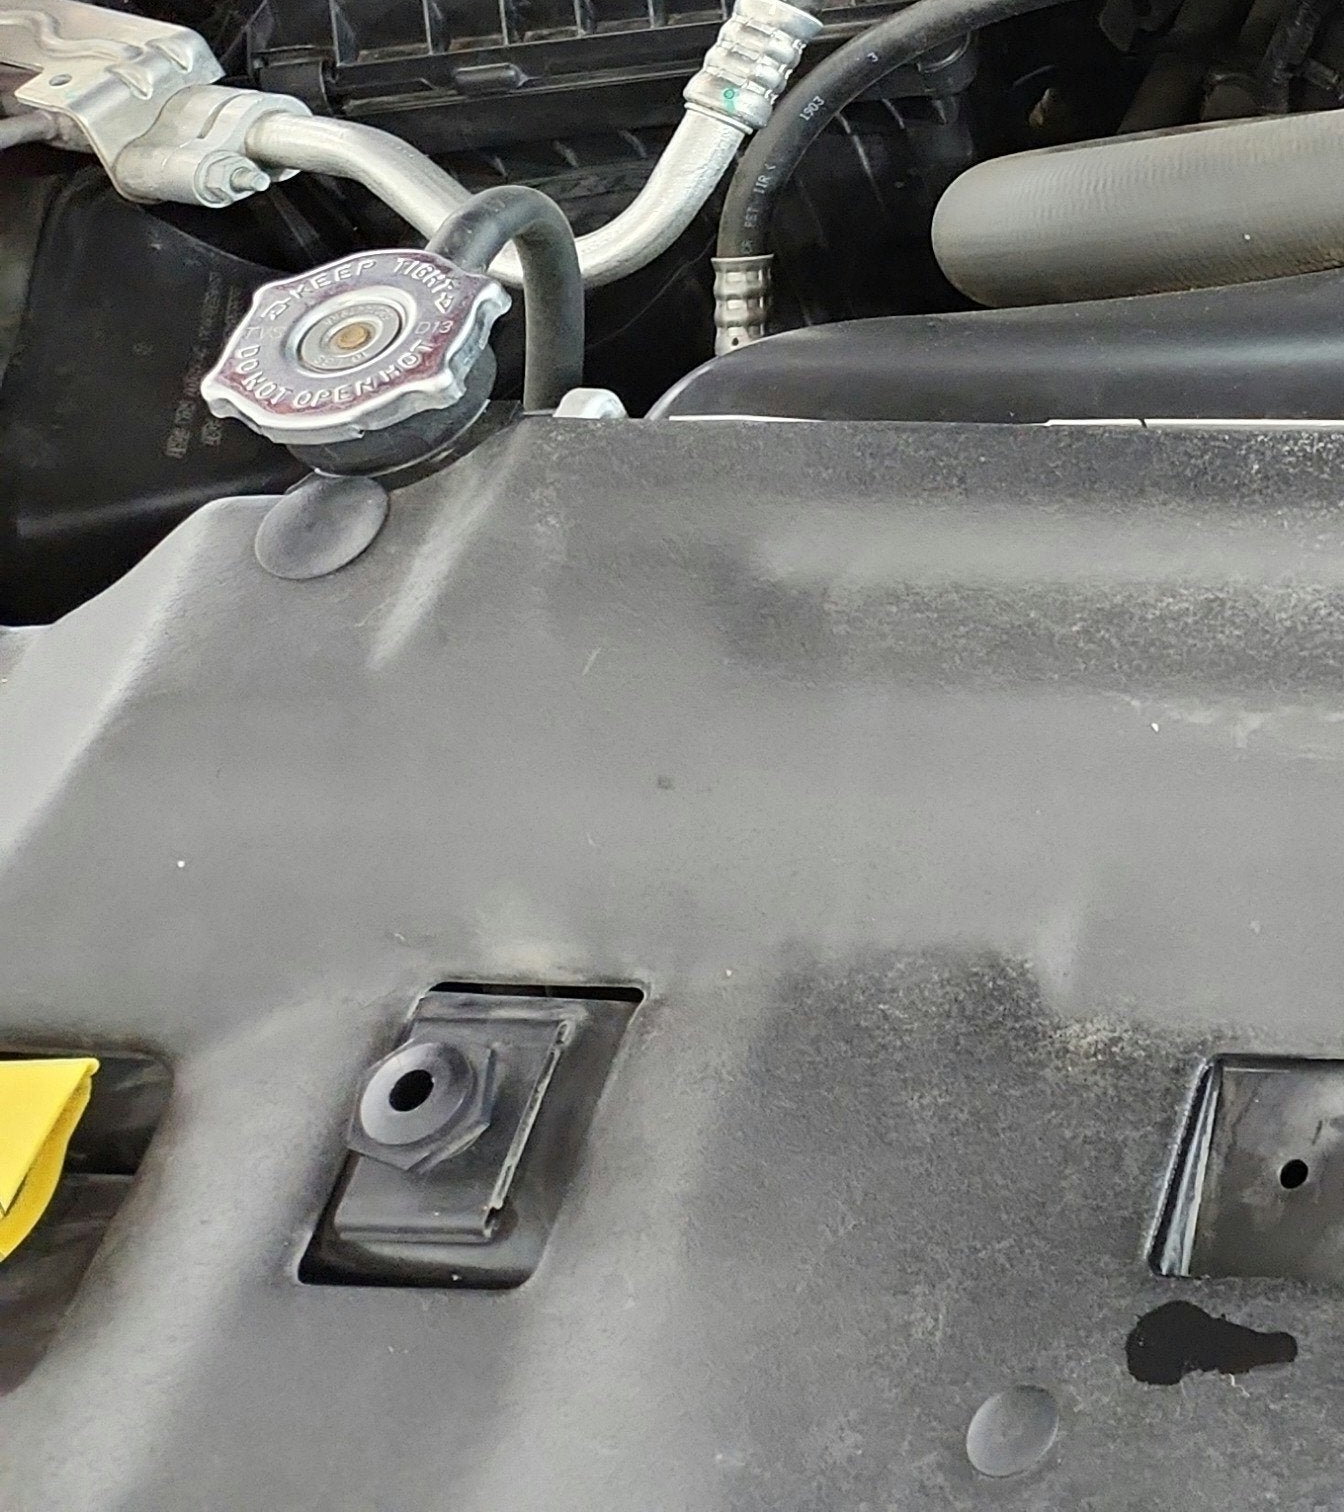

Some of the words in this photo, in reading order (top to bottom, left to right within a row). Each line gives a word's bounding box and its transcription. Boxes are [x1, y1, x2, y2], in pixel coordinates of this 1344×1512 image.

[289, 259, 376, 300] KEEP
[394, 257, 459, 294] TIGHT
[414, 319, 454, 335] D13
[292, 377, 378, 408] OPEN
[380, 338, 435, 382] HOT
